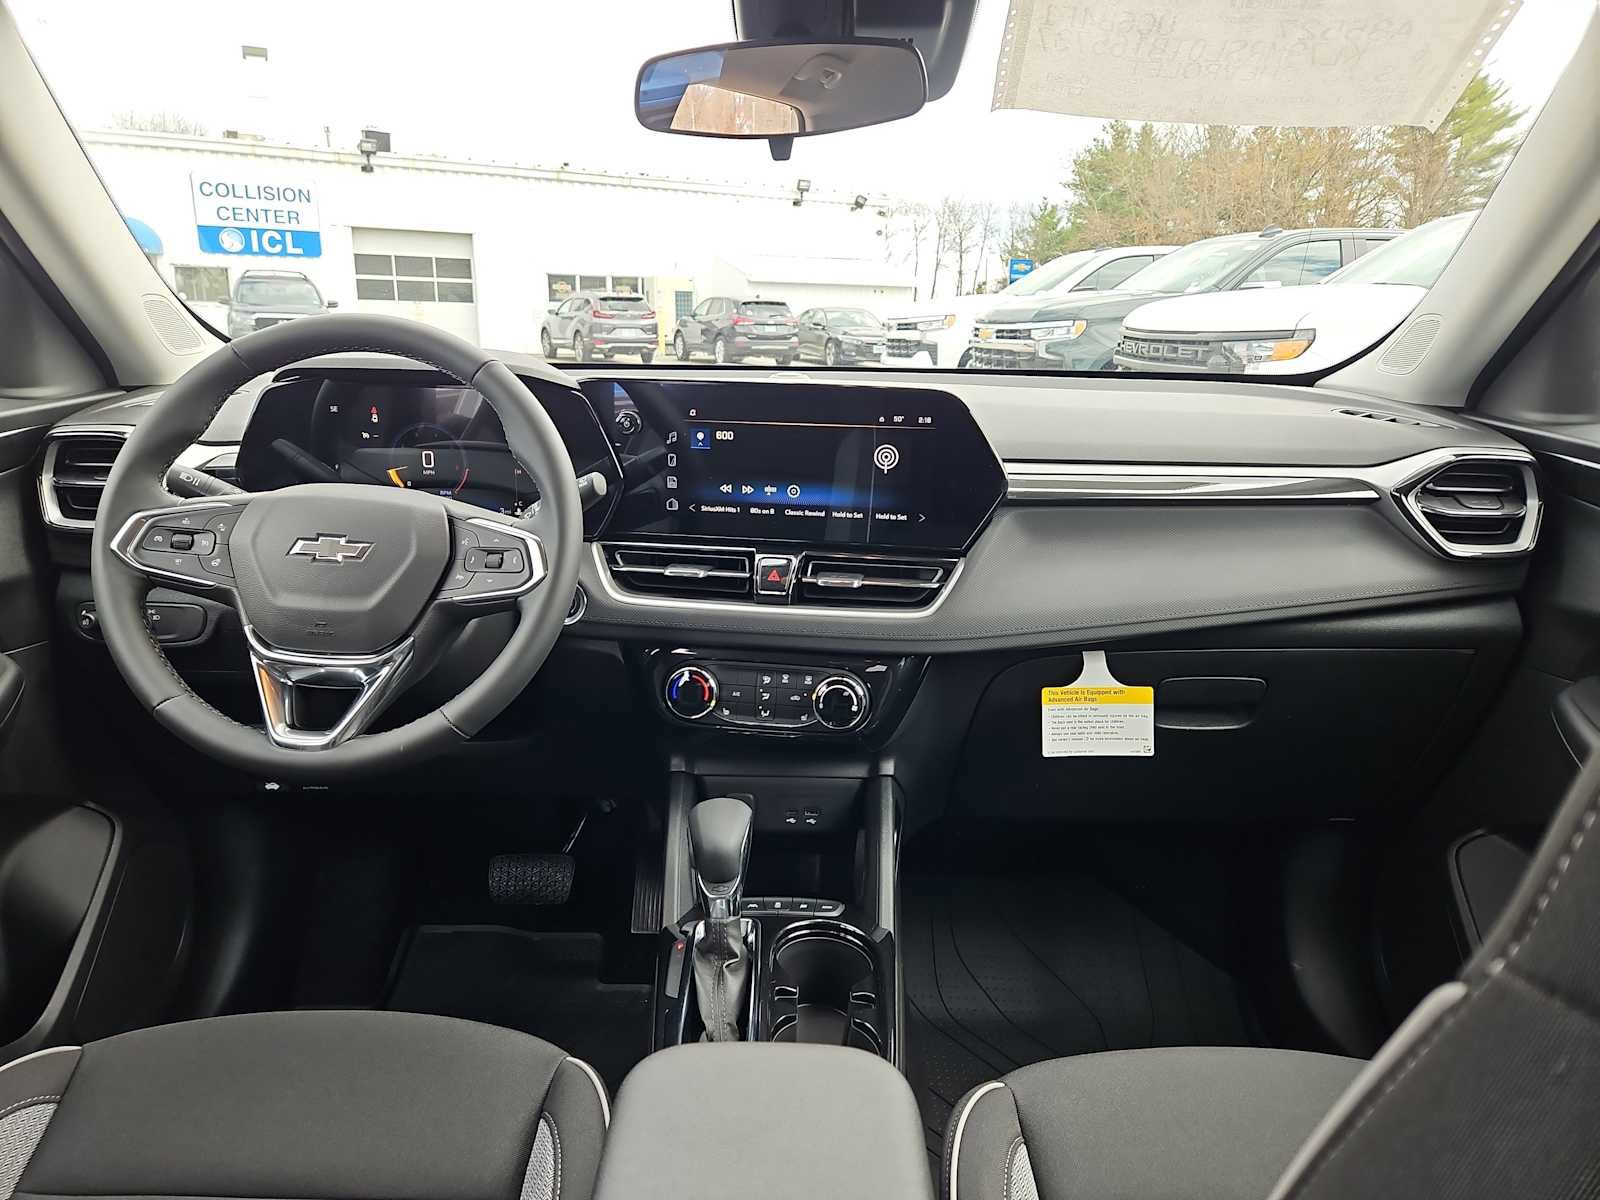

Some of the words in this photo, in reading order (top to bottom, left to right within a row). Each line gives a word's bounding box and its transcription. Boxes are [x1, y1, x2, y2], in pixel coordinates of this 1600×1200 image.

[199, 181, 311, 203] COLLISION
[216, 205, 300, 224] CENTER
[251, 230, 304, 255] ICL
[715, 430, 734, 441] 600
[421, 450, 435, 468] 0
[784, 509, 804, 517] Classic
[804, 510, 826, 518] Rewind
[832, 511, 846, 519] Hold
[853, 512, 864, 520] Set
[875, 513, 890, 521] Hold
[889, 513, 897, 521] to
[896, 513, 908, 521] Set
